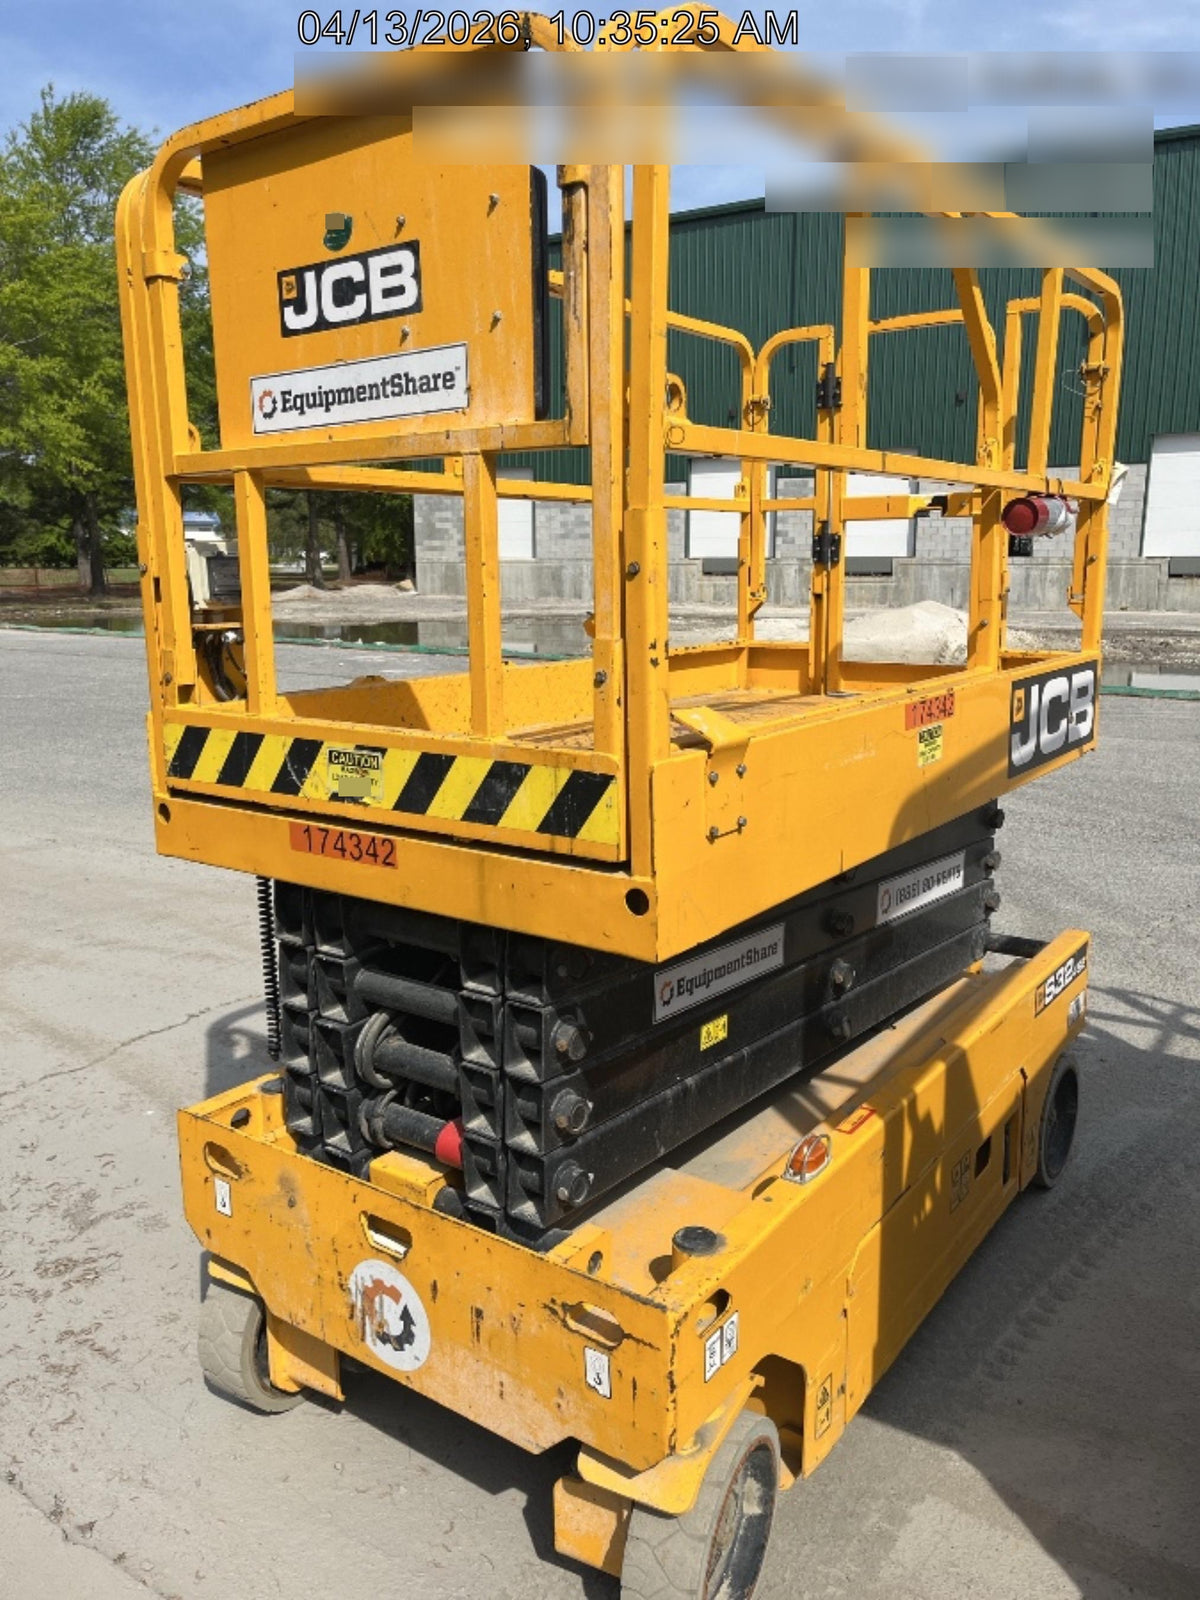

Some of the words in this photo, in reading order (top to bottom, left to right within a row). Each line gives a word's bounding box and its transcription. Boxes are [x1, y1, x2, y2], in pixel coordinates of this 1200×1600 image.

[283, 249, 419, 330] JCB
[280, 370, 456, 415] EquipmentShare
[1011, 669, 1095, 767] JCB
[331, 751, 378, 770] CAUTION
[303, 825, 396, 867] 174342
[676, 941, 779, 998] EquipmentShare
